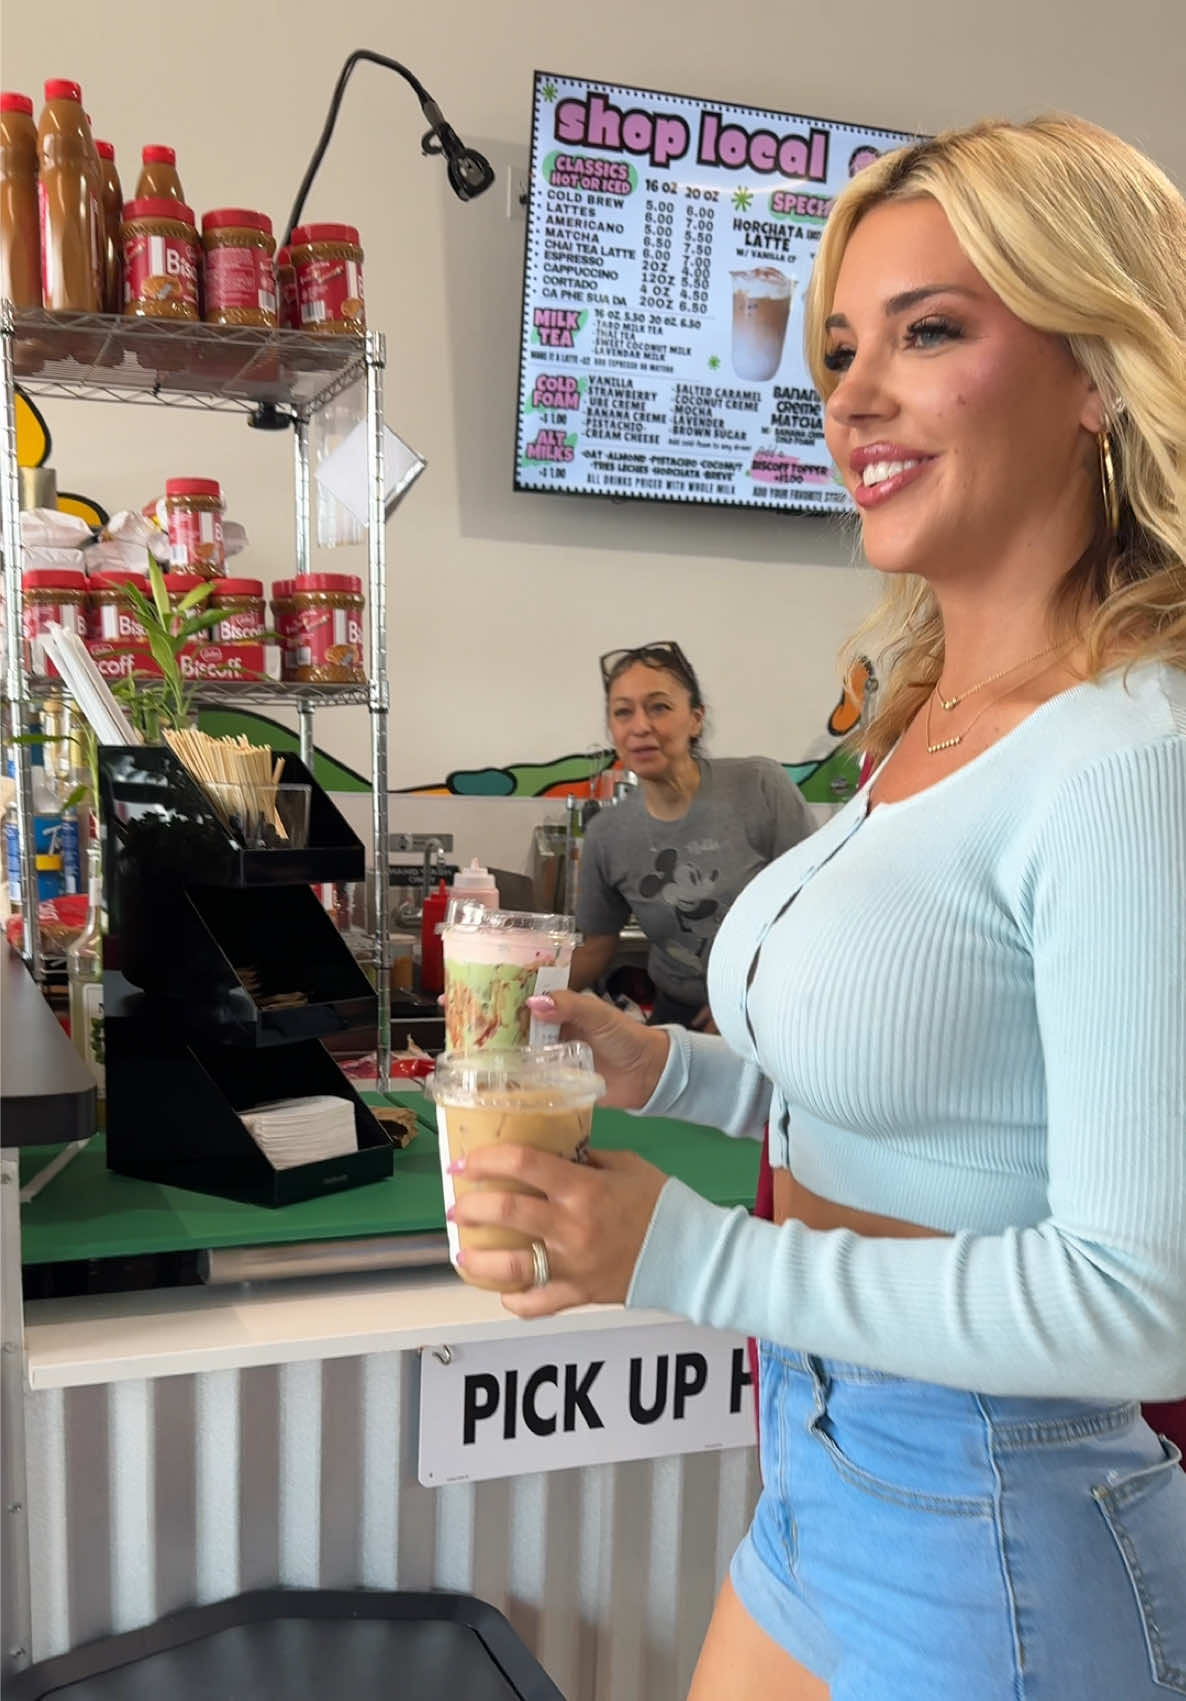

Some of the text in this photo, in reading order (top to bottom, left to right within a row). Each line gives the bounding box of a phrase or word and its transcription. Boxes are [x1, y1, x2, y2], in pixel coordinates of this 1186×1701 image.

[554, 91, 690, 168] shop
[697, 110, 830, 183] local
[555, 153, 629, 180] CLASSICS
[550, 170, 632, 195] HOT OR ICED
[645, 179, 658, 192] 16
[685, 186, 701, 199] 20
[547, 189, 624, 208] COLD BREW
[546, 202, 596, 217] LATTES
[646, 200, 714, 219] 5.00 6.00
[546, 215, 624, 234] AMERICANO
[645, 212, 713, 231] 6.00 7.00
[733, 217, 803, 240] HORCHATA
[545, 227, 600, 243] MATCHA
[644, 224, 712, 244] 5.00 5.50
[744, 232, 791, 252] LATTE
[544, 239, 636, 260] CHAI TEA LATTE
[643, 236, 712, 256] 6.50 7.50
[643, 248, 671, 261] 6.00
[544, 251, 604, 267] ESPRESSO
[543, 262, 619, 280] CAPPUCCINO
[543, 275, 598, 290] CORTADO
[542, 287, 557, 298] CA
[533, 307, 581, 331] MILK
[538, 327, 574, 348] TEA
[535, 374, 578, 393] COLD
[589, 375, 633, 388] VANILLA
[532, 389, 580, 411] FOAM
[588, 386, 657, 401] STRAWBERRY
[676, 383, 762, 402] SALTED CARAMEL
[676, 395, 722, 408] COCONUT
[587, 407, 630, 419] BANANA
[674, 405, 712, 417] MOCHA
[673, 415, 724, 428] LAVENDER
[536, 429, 567, 447] ALT
[586, 428, 621, 440] CREAM
[673, 425, 747, 441] BROWN SUGAR
[526, 442, 574, 463] MILKS
[463, 1360, 606, 1445] PICK
[628, 1352, 709, 1425] UP
